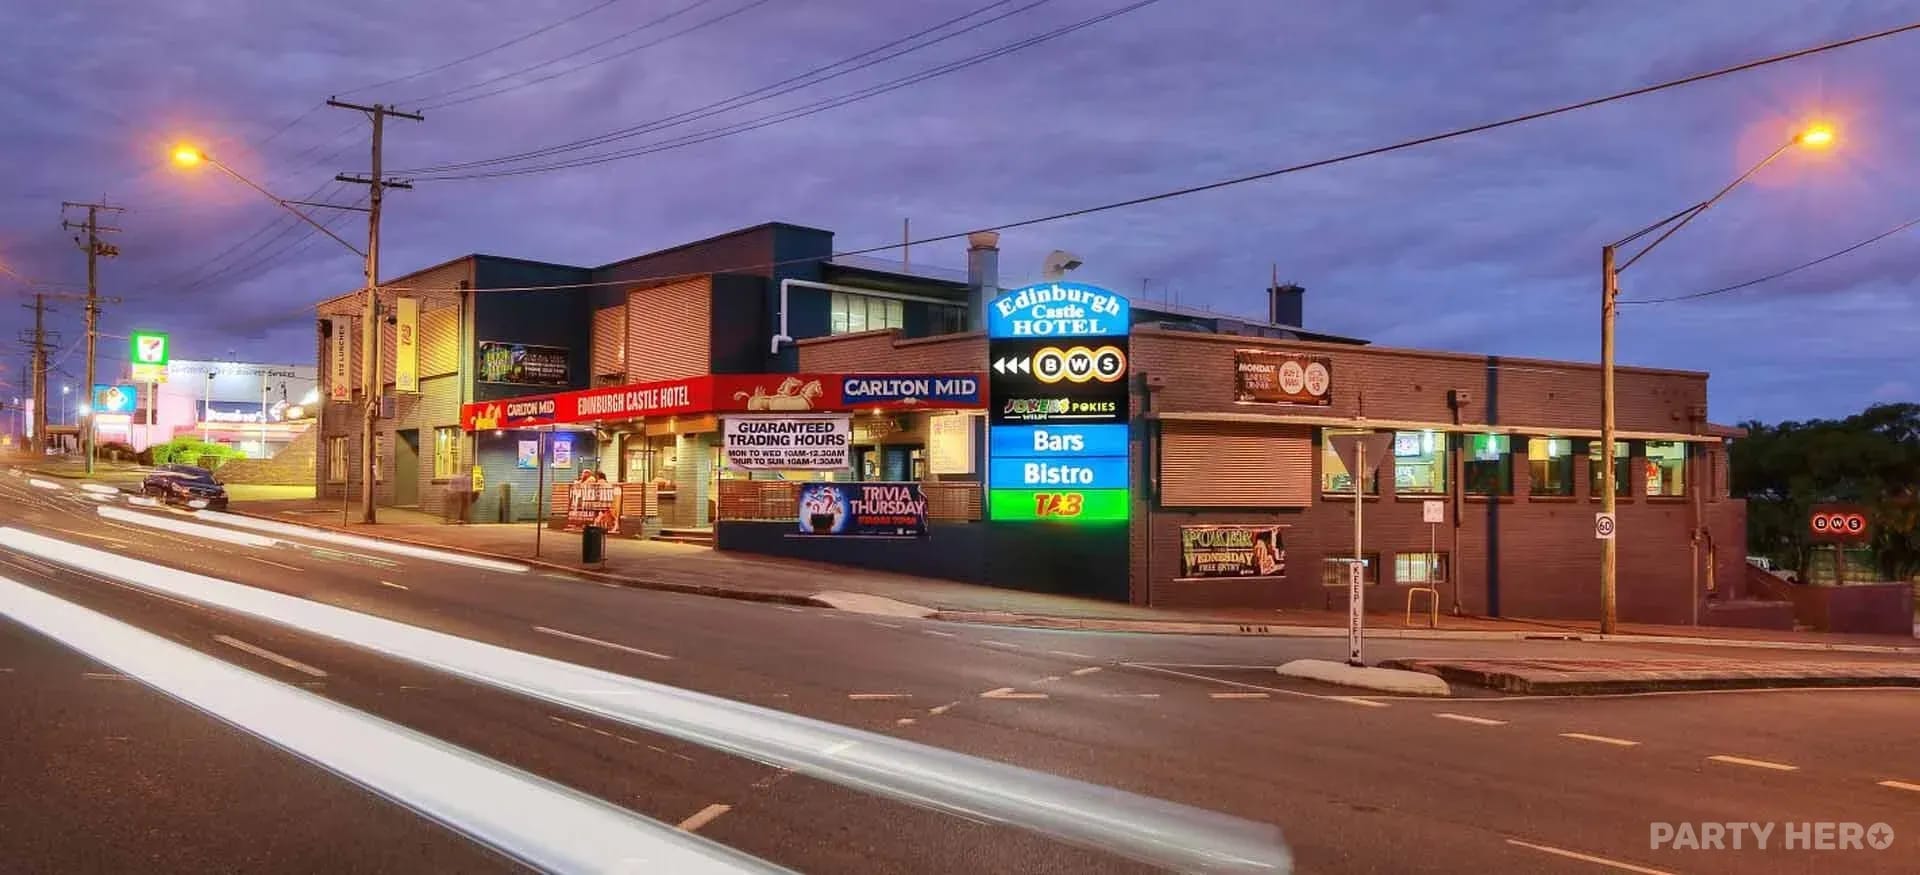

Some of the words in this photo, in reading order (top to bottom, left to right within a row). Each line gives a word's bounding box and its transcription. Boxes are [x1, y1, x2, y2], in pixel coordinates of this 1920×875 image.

[996, 284, 1120, 318] Edinburgh
[1032, 304, 1085, 318] Castle
[1012, 319, 1106, 335] HOTEL
[1045, 358, 1114, 372] BWS
[1238, 363, 1276, 373] MONDAY
[844, 379, 929, 396] CARLTON
[935, 379, 976, 396] MID
[578, 395, 624, 416] EDINBURGH
[626, 389, 659, 410] CASTLE
[660, 385, 690, 408] HOTEL
[1004, 398, 1070, 414] JOKERS
[1072, 402, 1116, 412] POKIES
[507, 401, 538, 417] CARLTON
[539, 400, 555, 414] MID
[738, 422, 835, 434] GUARANTEED
[728, 434, 790, 446] TRADING
[794, 434, 845, 446] HOURS
[1033, 430, 1084, 451] Bars
[1024, 462, 1093, 484] Bistro
[862, 486, 911, 501] TRIVIA
[849, 500, 925, 515] THURSDAY
[1035, 493, 1084, 516] TAB
[1599, 521, 1611, 531] 60
[1817, 518, 1858, 528] BWS
[1184, 530, 1254, 547] POKER
[1184, 552, 1254, 567] WEDNESDAY
